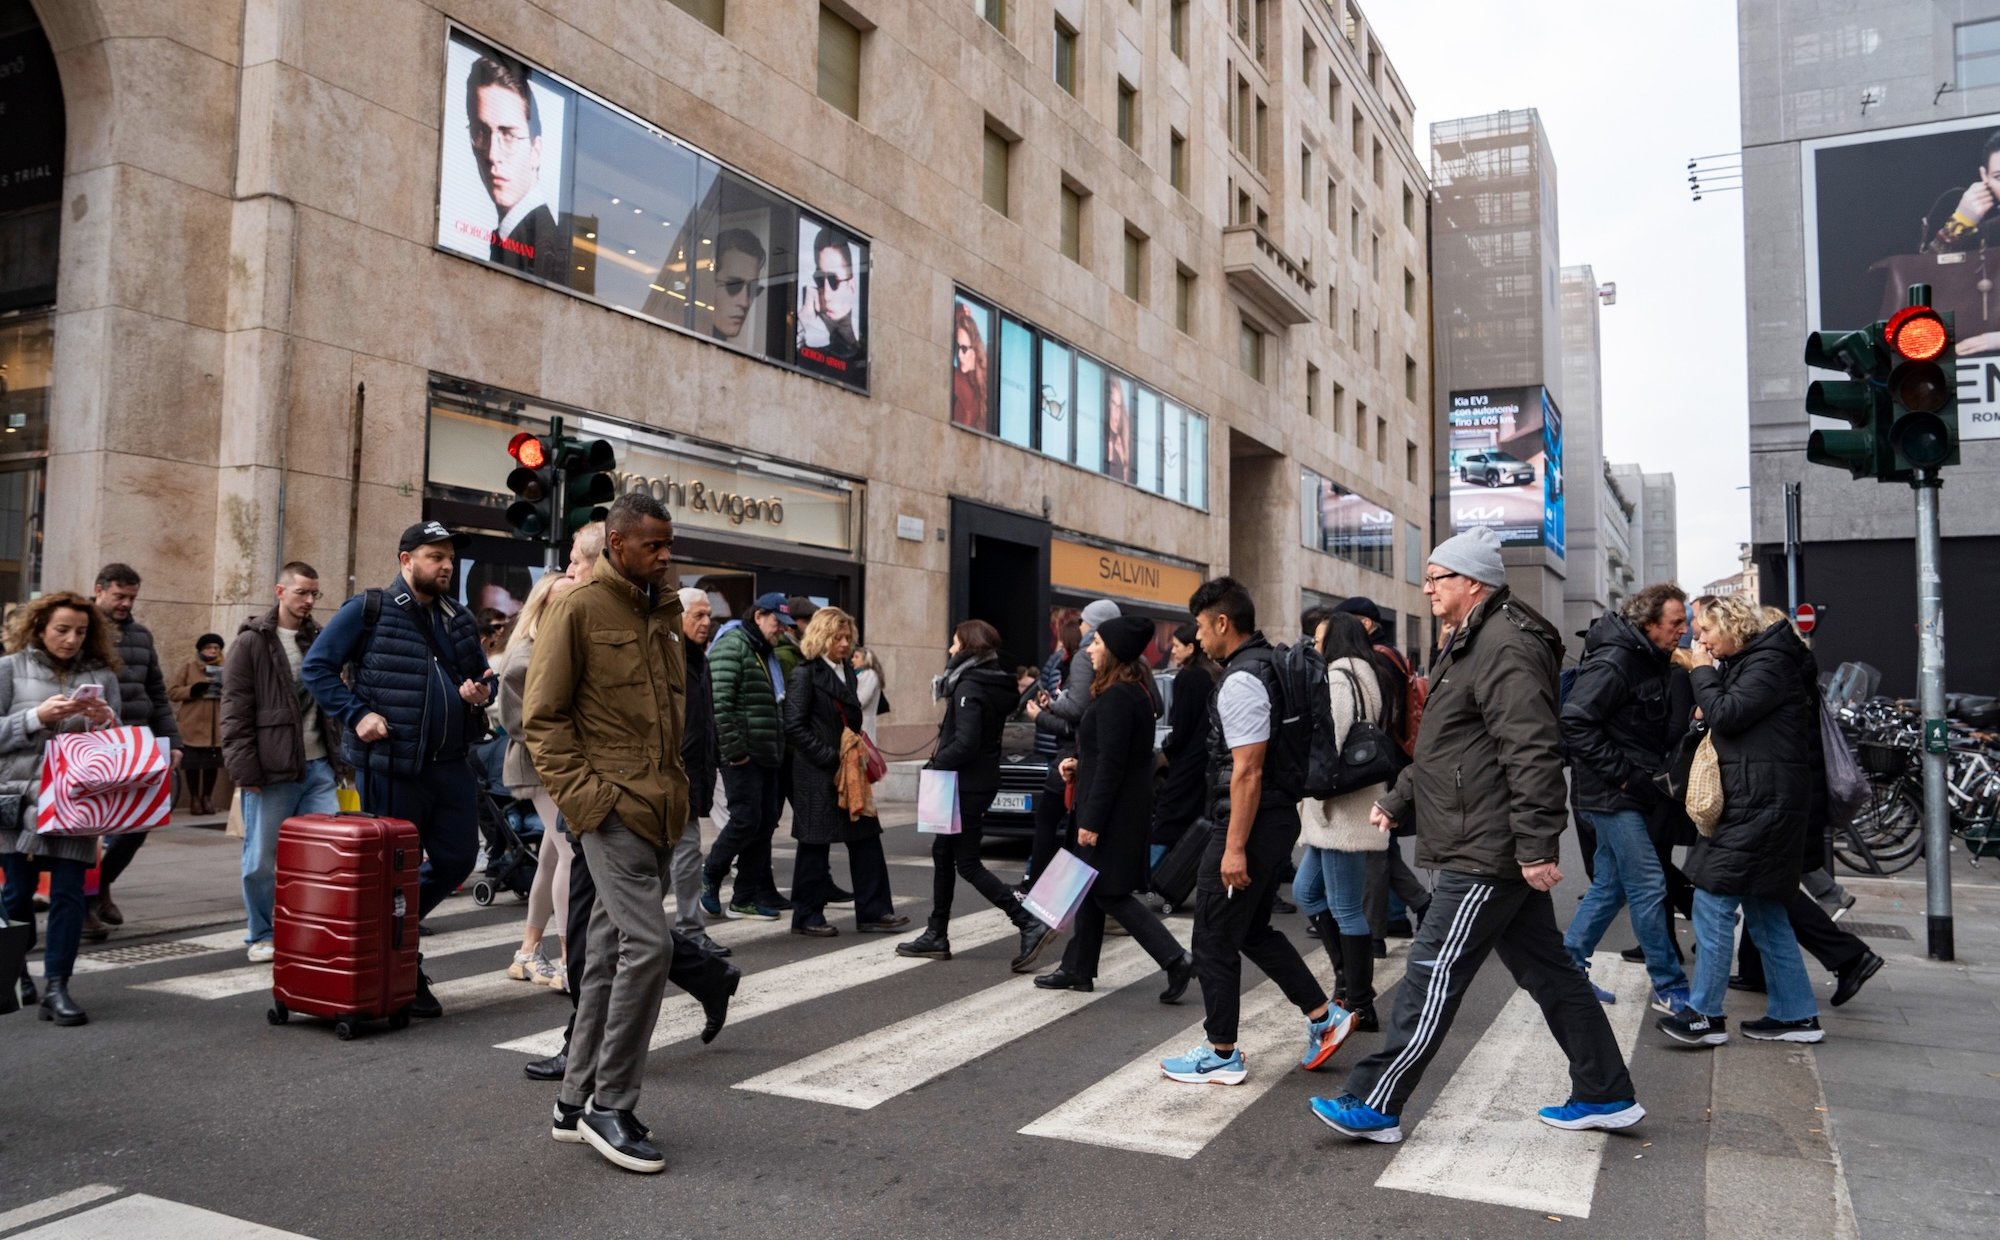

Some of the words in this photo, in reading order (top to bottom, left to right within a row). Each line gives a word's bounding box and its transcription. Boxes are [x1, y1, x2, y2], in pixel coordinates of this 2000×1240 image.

[14, 164, 52, 183] TRIAL
[1454, 397, 1470, 407] Kia
[1470, 395, 1489, 406] EV3
[1454, 408, 1472, 416] con
[1472, 404, 1519, 415] autonomia
[1455, 417, 1472, 427] fino
[1481, 415, 1498, 426] 605
[691, 480, 709, 511] &
[1456, 506, 1505, 520] KIA
[1099, 556, 1160, 588] SALVINI
